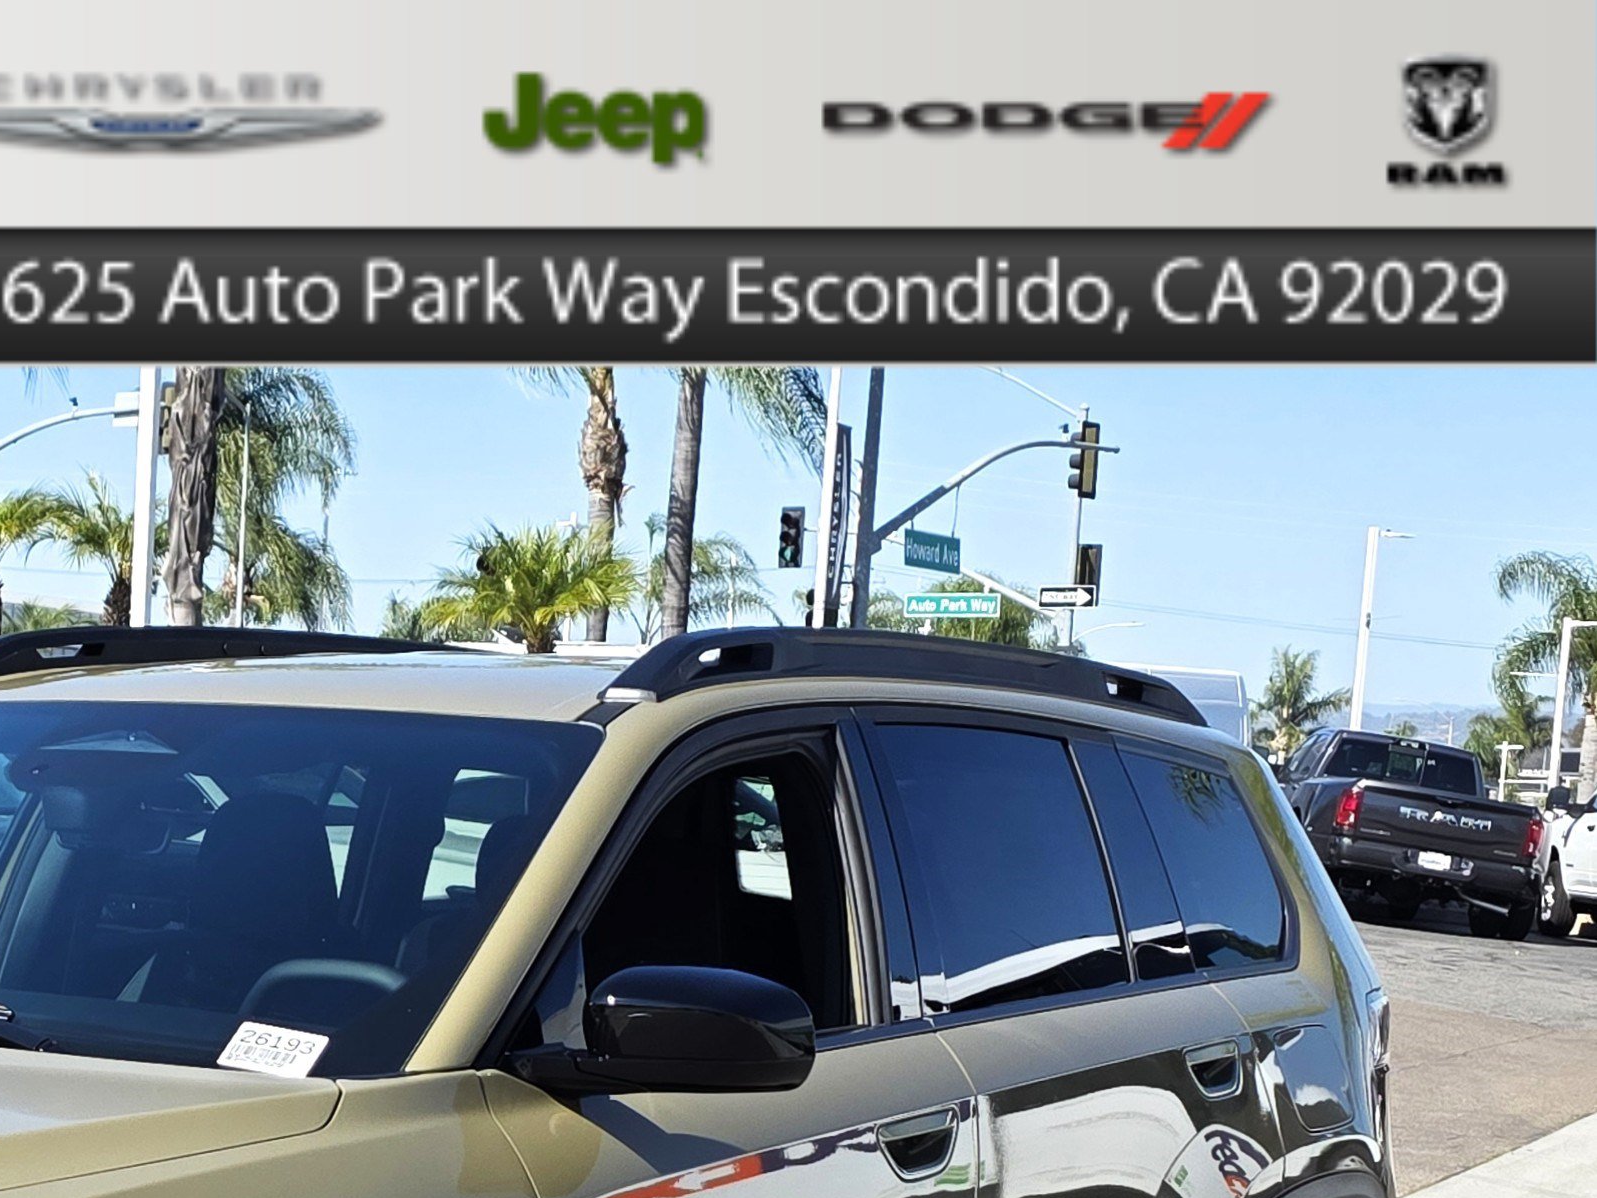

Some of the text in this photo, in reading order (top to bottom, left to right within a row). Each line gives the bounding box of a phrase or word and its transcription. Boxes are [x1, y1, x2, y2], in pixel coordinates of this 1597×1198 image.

[906, 538, 958, 567] Howard Ave
[908, 598, 996, 614] Auto Park Way
[1400, 806, 1492, 831] RAM
[240, 1029, 315, 1055] 26193
